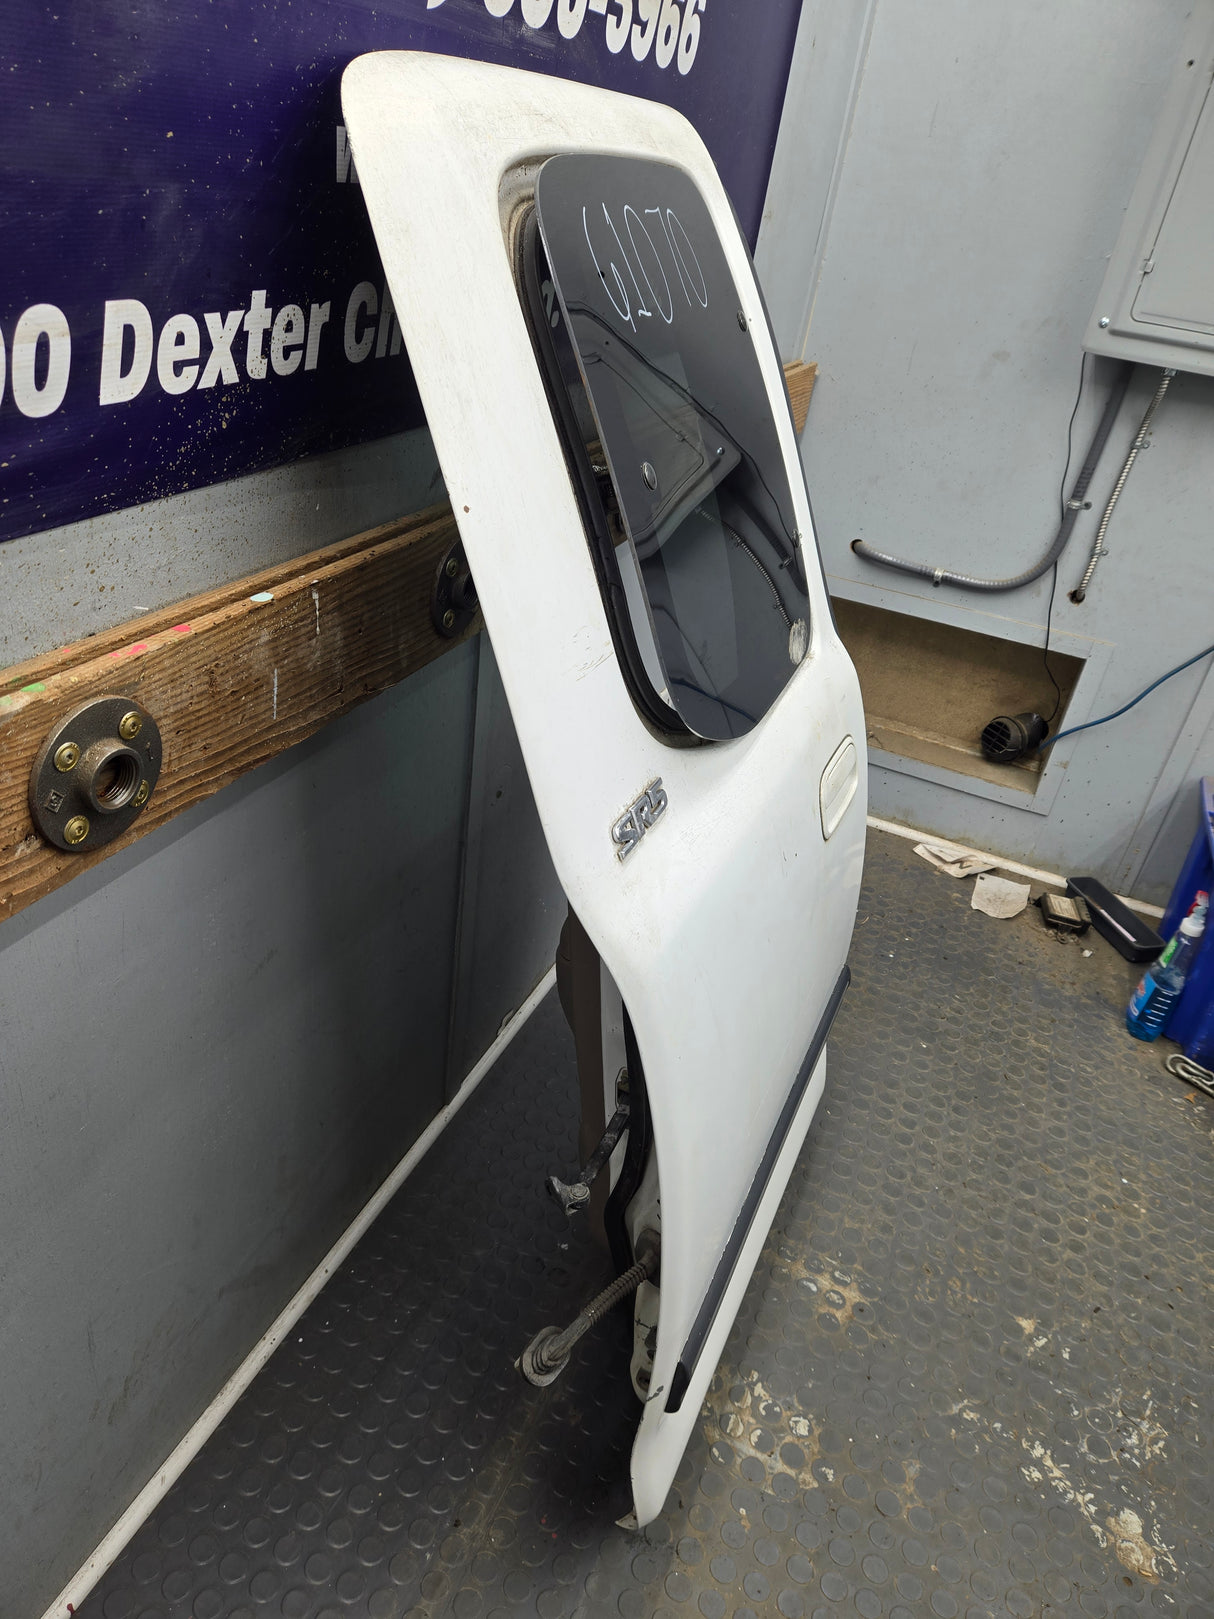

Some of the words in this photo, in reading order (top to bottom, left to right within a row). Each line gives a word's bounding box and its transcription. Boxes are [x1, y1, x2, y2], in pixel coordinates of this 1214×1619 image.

[0, 303, 72, 419] 0
[99, 288, 332, 406] Dexter
[611, 776, 668, 863] SR5
